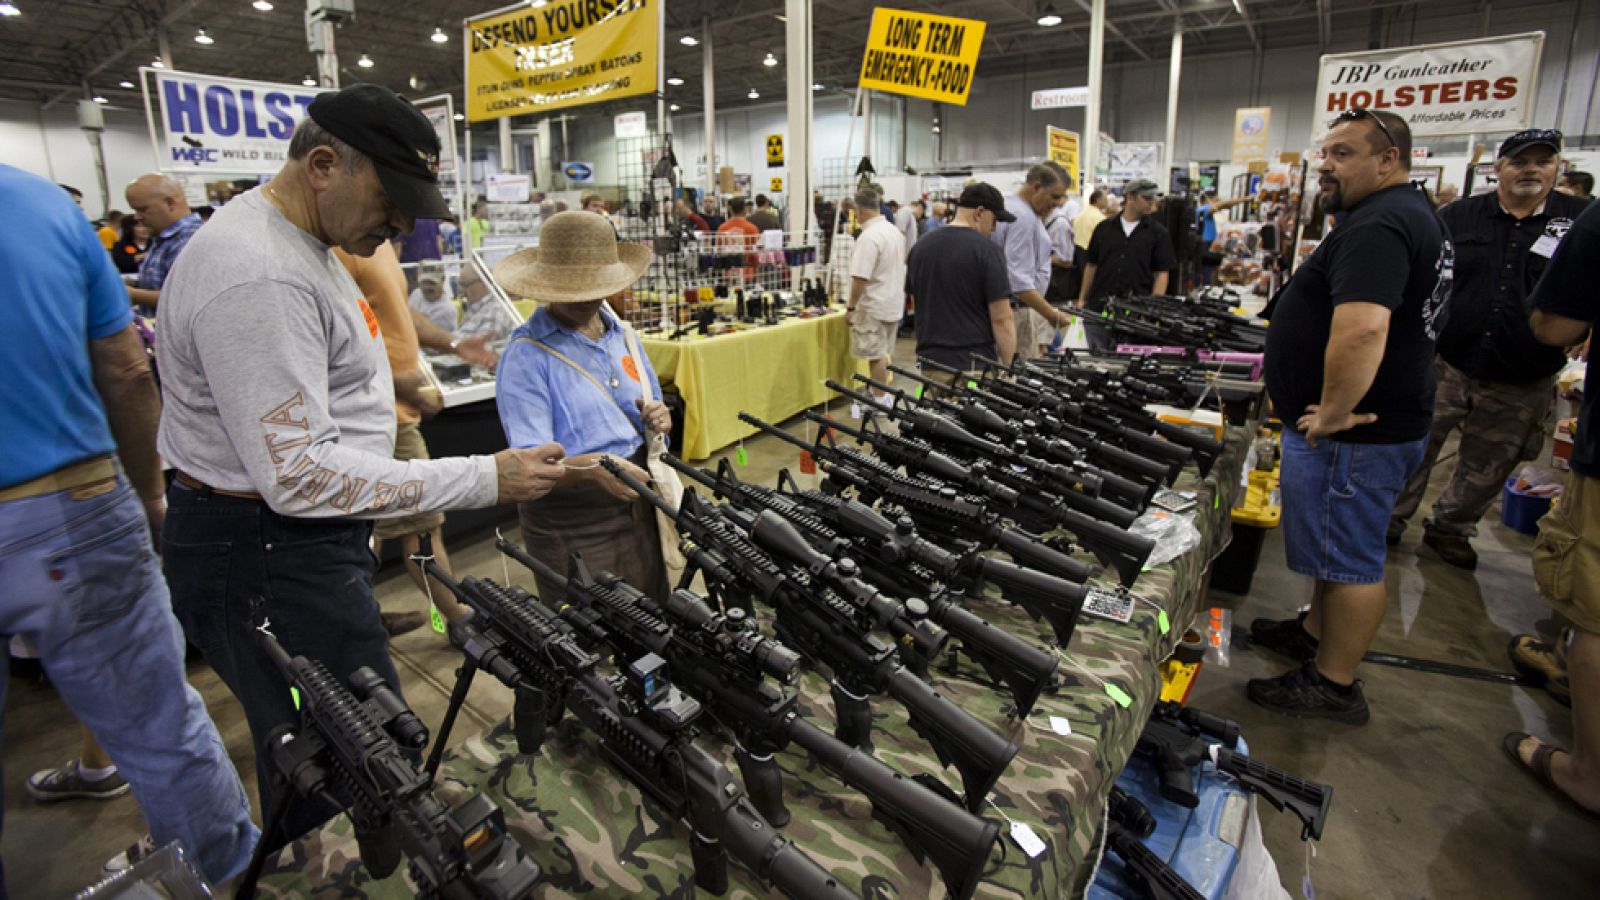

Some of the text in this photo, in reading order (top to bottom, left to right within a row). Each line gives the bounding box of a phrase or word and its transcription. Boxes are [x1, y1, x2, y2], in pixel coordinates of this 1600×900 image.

[473, 15, 538, 53] DEFEND
[885, 16, 966, 57] LONG TERM
[600, 51, 643, 73] BATONS
[864, 48, 970, 95] EMERGENCY-FOOD
[1331, 57, 1493, 85] JBP Gunleather
[1326, 76, 1519, 112] HOLSTERS
[1408, 107, 1506, 125] Affordable Prices
[222, 150, 259, 161] WILD
